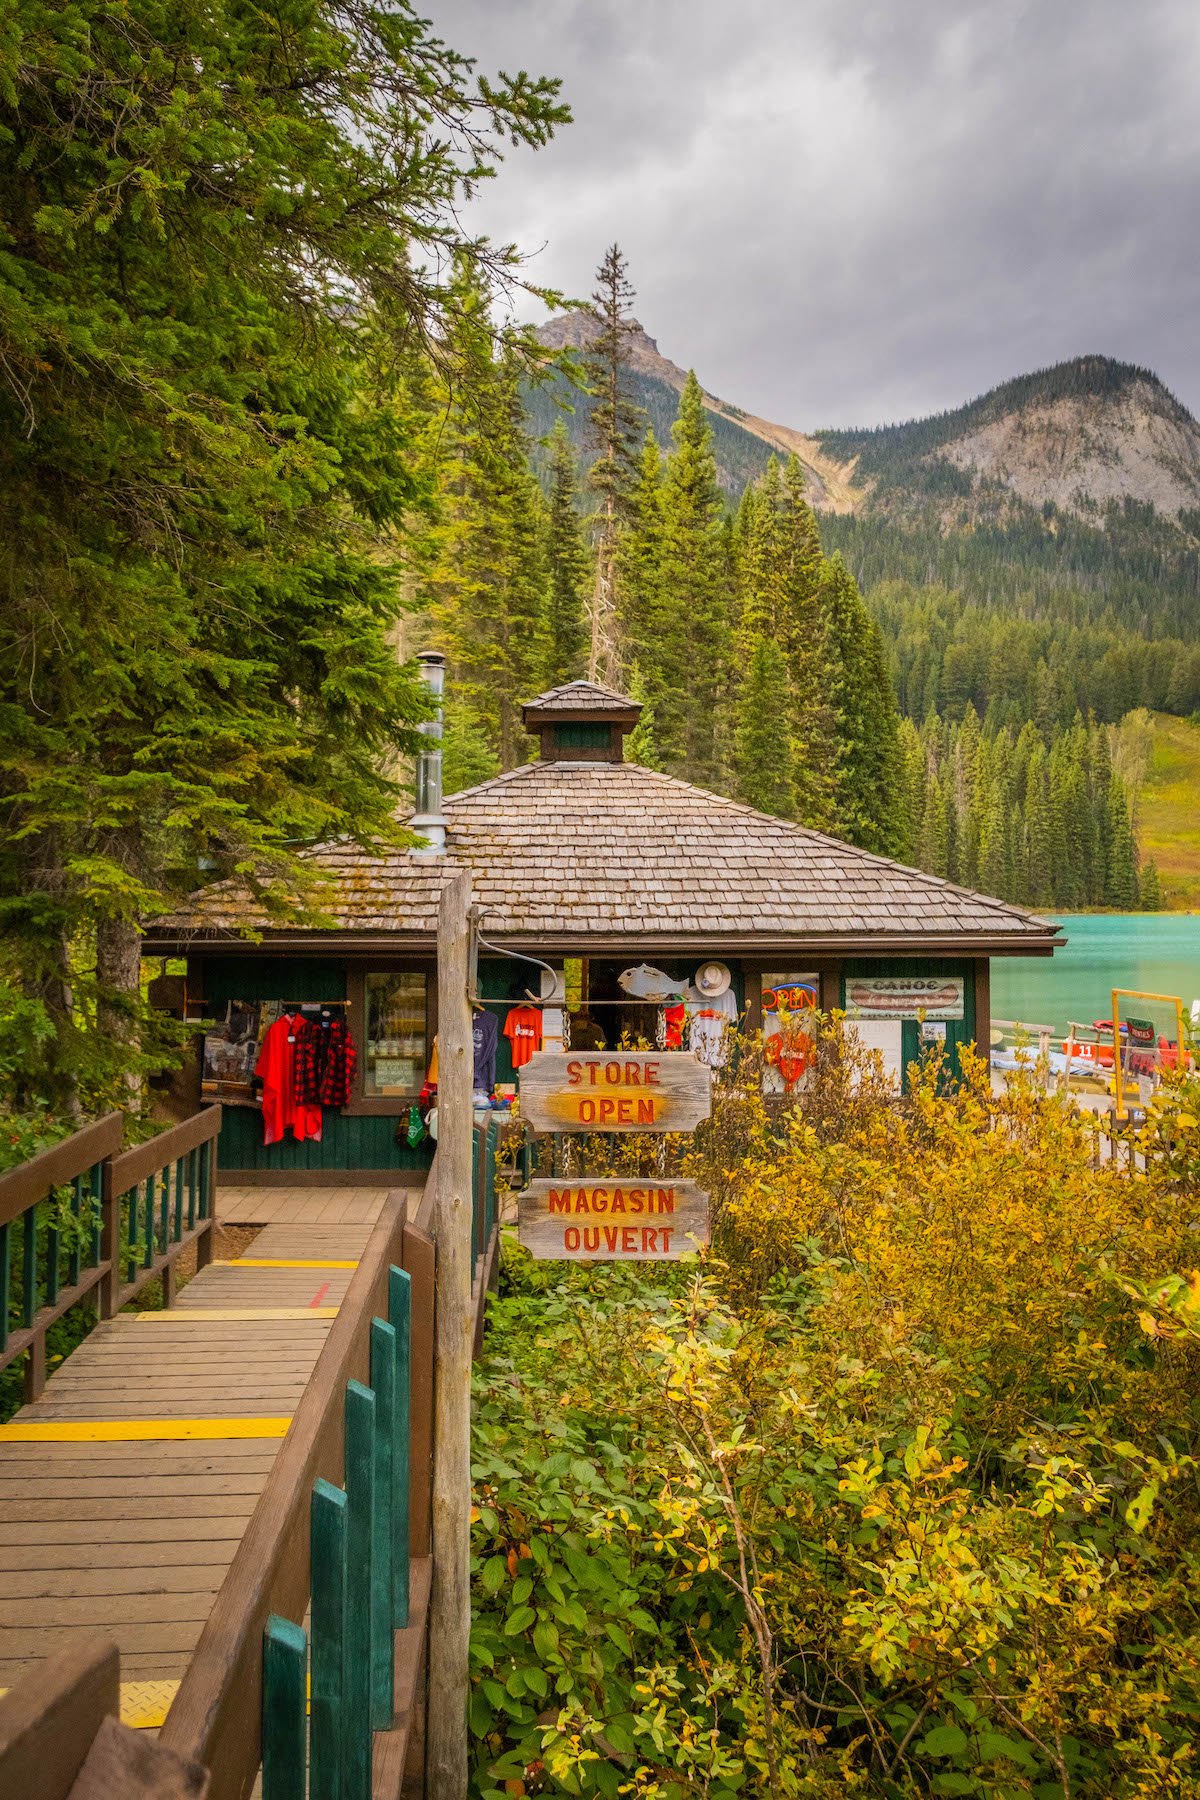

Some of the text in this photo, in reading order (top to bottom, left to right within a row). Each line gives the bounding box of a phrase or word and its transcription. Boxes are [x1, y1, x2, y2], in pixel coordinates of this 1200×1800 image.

[872, 980, 939, 990] CANOE
[762, 989, 816, 1009] OPEN
[1079, 1045, 1092, 1057] 11
[566, 1061, 660, 1086] STORE
[578, 1099, 654, 1125] OPEN
[548, 1188, 675, 1214] MAGASIN
[564, 1226, 675, 1253] OUVERT
